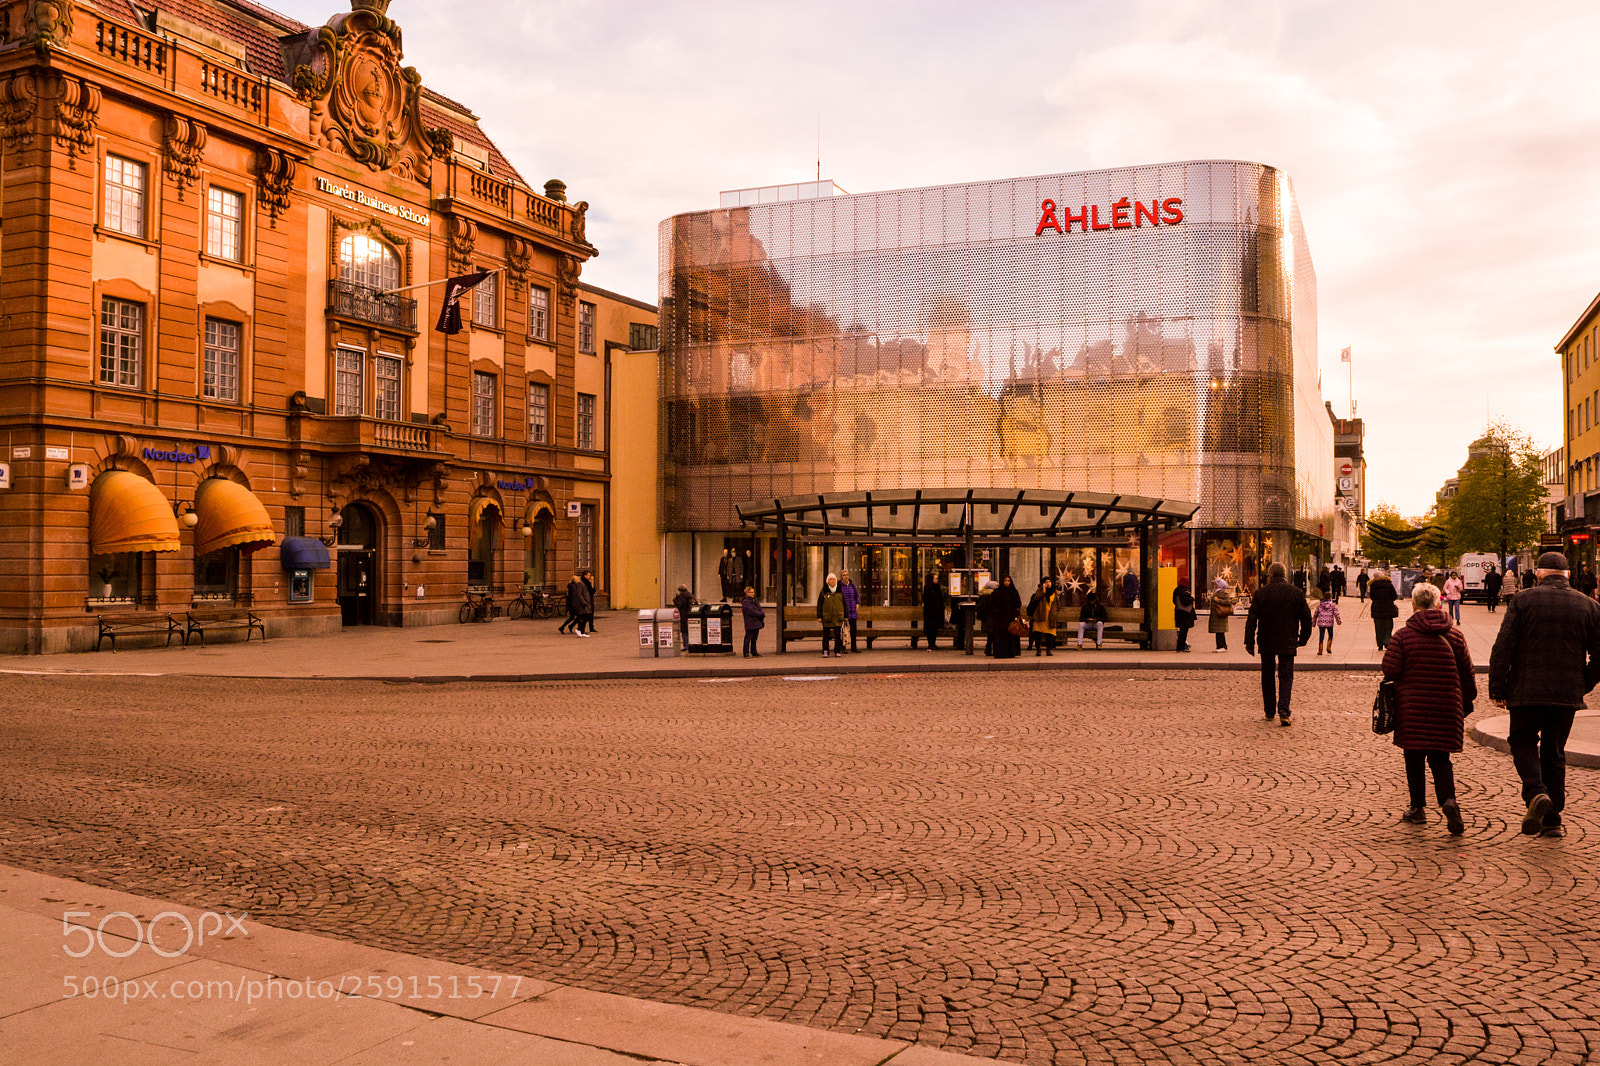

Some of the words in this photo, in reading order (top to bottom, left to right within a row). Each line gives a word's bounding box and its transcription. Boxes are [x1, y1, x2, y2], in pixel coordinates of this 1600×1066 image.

[317, 176, 355, 201] Thorén
[357, 190, 398, 216] Business
[399, 205, 430, 227] School
[1035, 196, 1184, 236] ÅHLÉNS
[144, 447, 197, 463] Nordea
[497, 480, 527, 491] Nordea
